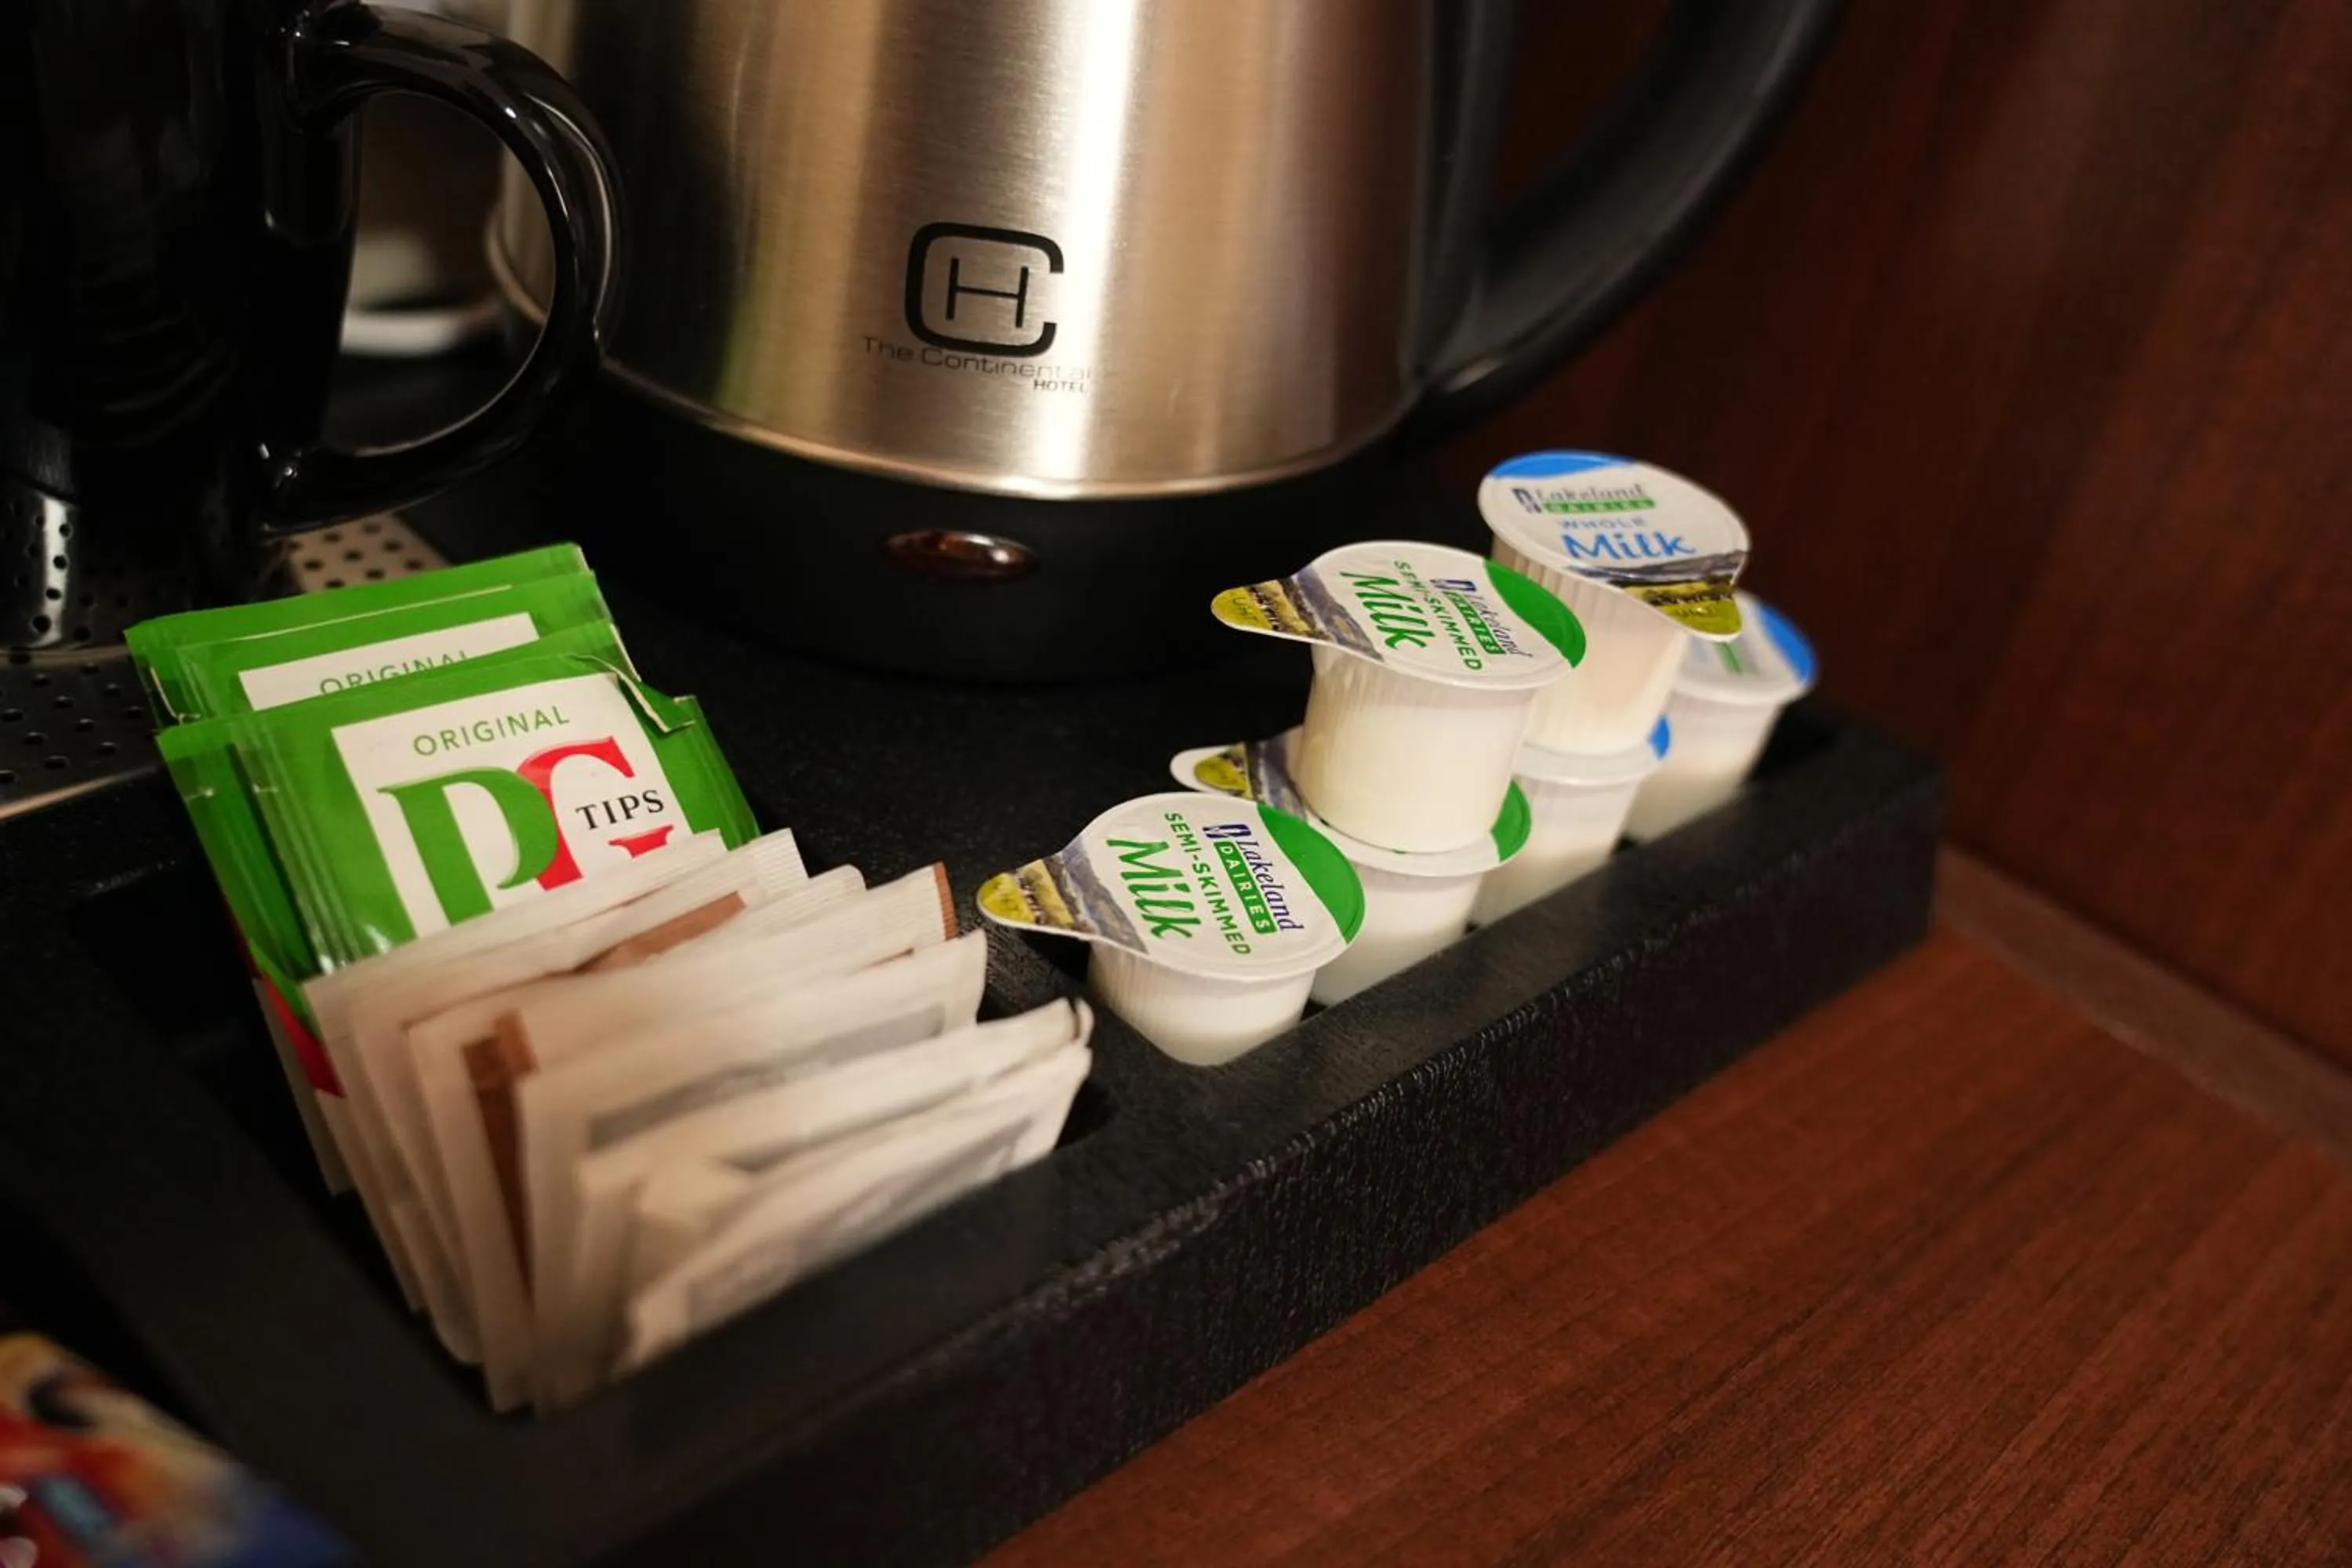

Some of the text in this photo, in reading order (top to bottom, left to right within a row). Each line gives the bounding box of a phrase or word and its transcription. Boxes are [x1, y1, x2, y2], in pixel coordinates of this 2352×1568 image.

[863, 336, 1092, 379] The Continental
[1033, 379, 1087, 393] HOTEL
[1562, 530, 1696, 560] Milk
[1339, 571, 1436, 650] Milk
[1394, 560, 1483, 670] SEMI-SKIMMED
[413, 706, 570, 757] ORIGINAL
[575, 789, 665, 830] TIPS
[1105, 839, 1202, 938] Milk
[1164, 812, 1252, 955] SEMI-SKIMMED
[1220, 846, 1271, 930] DAIRIES
[1236, 840, 1305, 931] Lakeland
